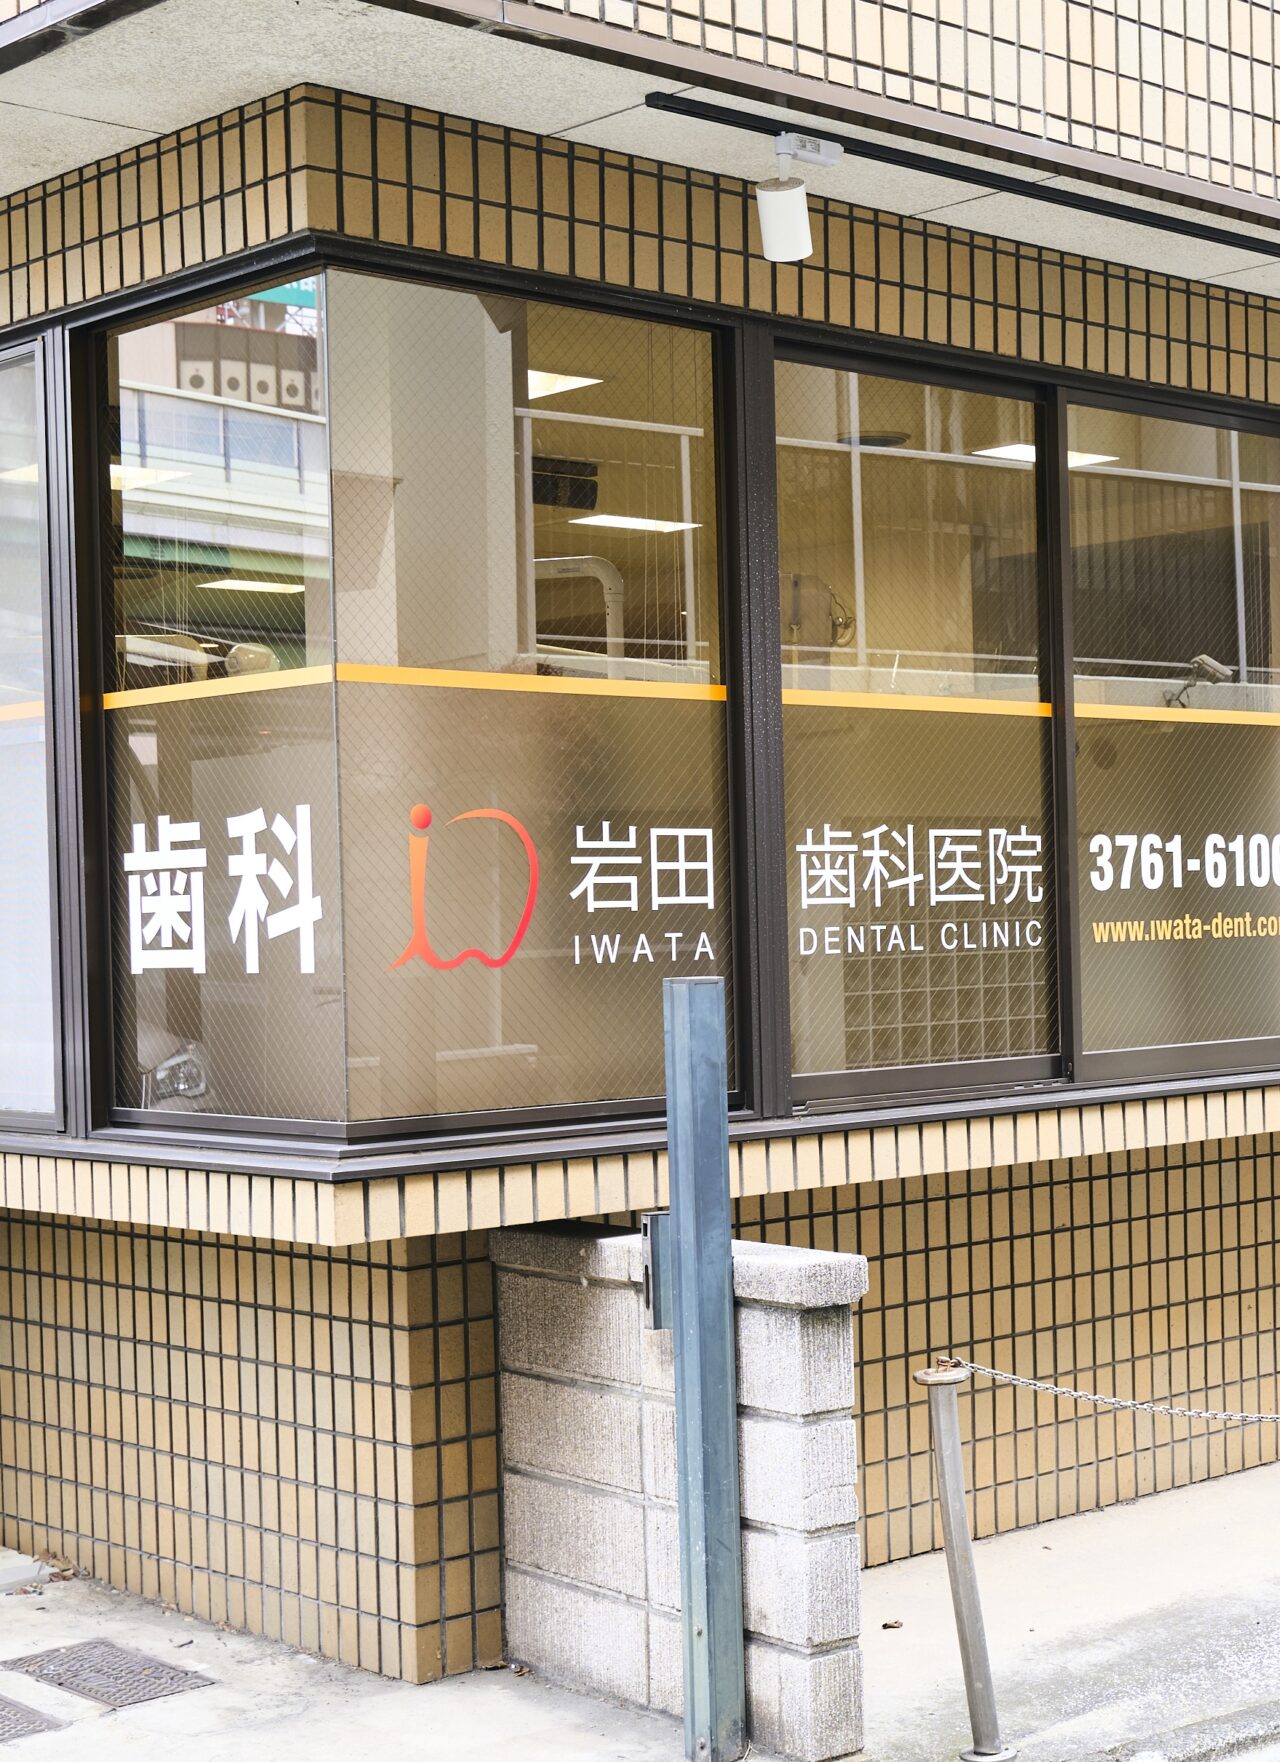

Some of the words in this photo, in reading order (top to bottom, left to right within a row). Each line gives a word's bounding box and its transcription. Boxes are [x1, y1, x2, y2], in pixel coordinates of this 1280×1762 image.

[123, 804, 323, 975] 歯科
[569, 820, 716, 914] 岩田
[795, 823, 1045, 909] 歯科医院
[573, 931, 716, 966] IWATA
[799, 923, 925, 956] DENTAL
[941, 919, 1044, 951] CLINIC
